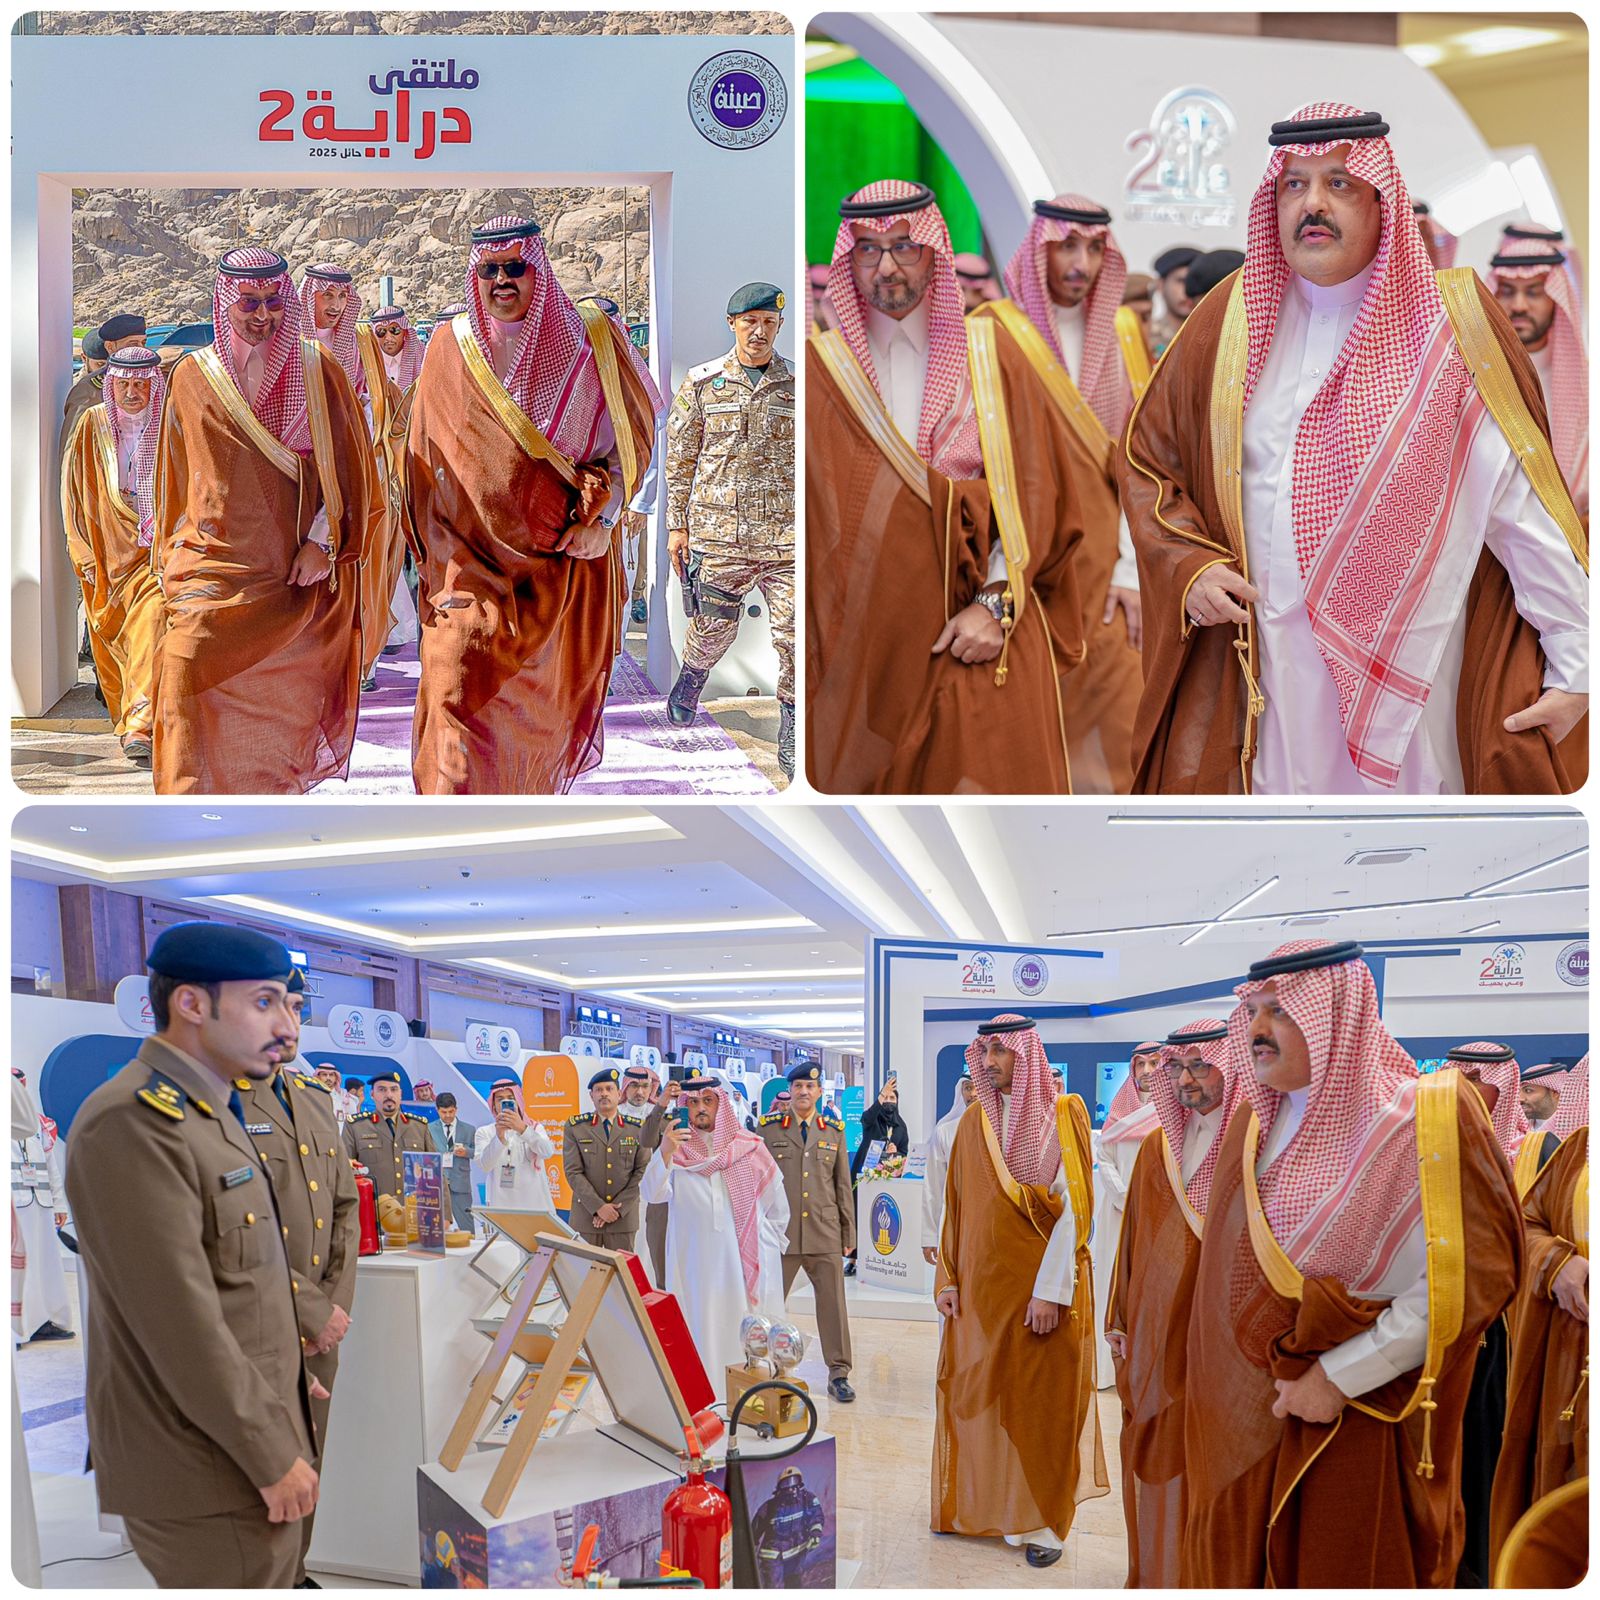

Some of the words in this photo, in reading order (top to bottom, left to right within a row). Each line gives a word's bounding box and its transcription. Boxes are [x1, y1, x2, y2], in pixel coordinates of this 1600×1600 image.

[369, 59, 479, 95] ملتقى
[309, 148, 338, 157] 2025
[340, 148, 362, 158] حائل
[865, 1264, 888, 1275] University
